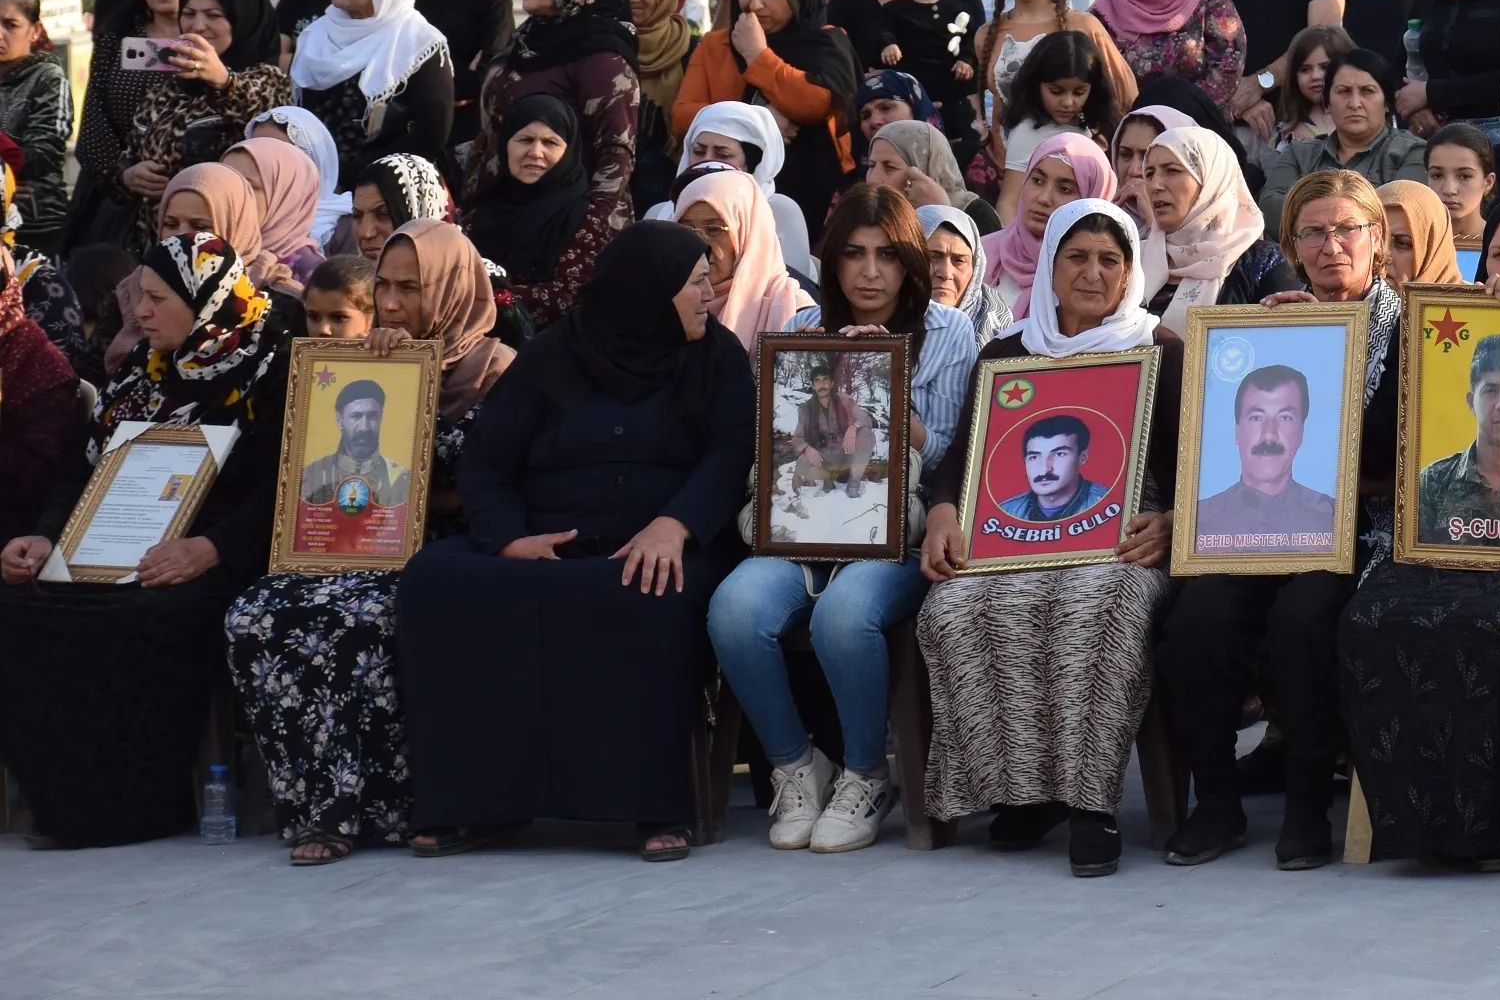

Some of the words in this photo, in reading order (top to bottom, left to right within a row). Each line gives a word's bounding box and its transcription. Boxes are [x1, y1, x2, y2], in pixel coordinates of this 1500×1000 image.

[983, 516, 1062, 542] Ş-SEBRÎ
[1068, 502, 1122, 536] GULO
[1198, 534, 1232, 550] ŞEHID
[1235, 533, 1289, 548] MUSTEFA
[1291, 532, 1333, 546] HENAN
